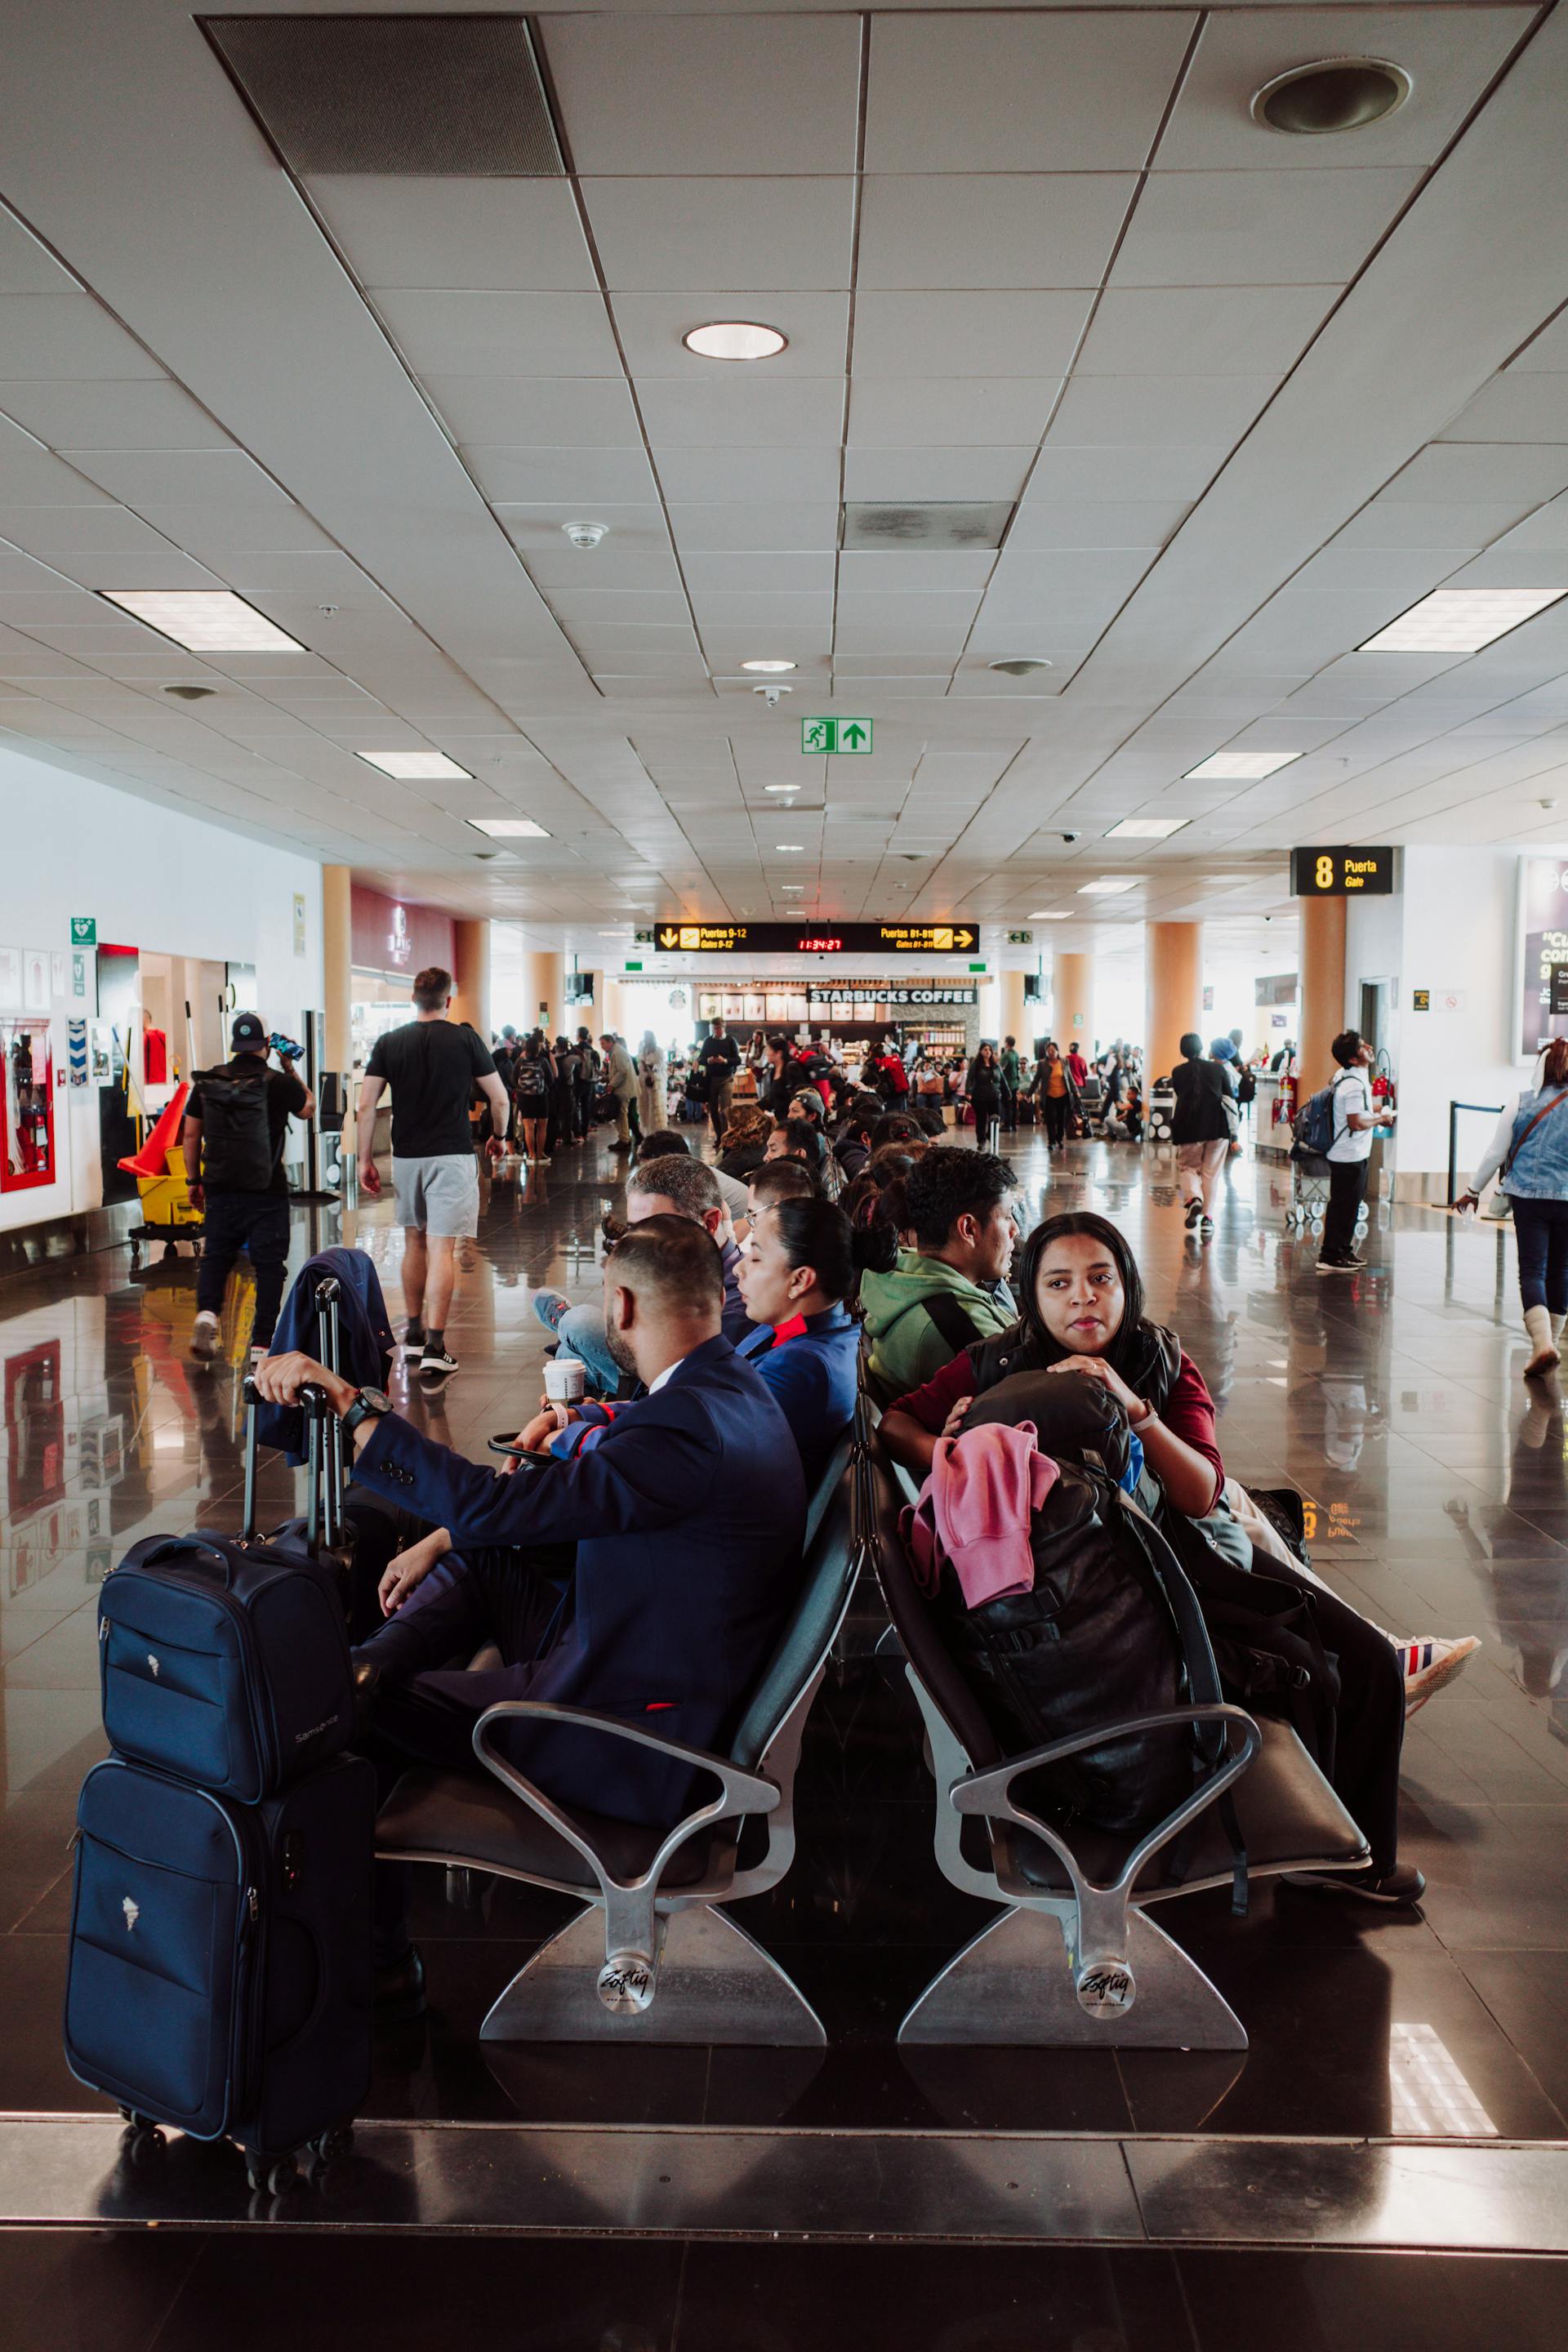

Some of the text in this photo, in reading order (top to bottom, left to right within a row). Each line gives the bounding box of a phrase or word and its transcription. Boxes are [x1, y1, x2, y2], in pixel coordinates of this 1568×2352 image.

[1315, 855, 1334, 889] 8
[1344, 860, 1377, 873] Puerta
[1344, 875, 1365, 888] Gate
[701, 928, 746, 938] Puertas 9-12
[881, 928, 908, 938] Puertas
[701, 940, 733, 948] Gates 9-12
[800, 940, 841, 950] 11:34:27
[896, 940, 913, 948] Gates
[810, 990, 973, 1003] STARBUCKS COFFEE
[295, 1715, 339, 1744] Samsonite
